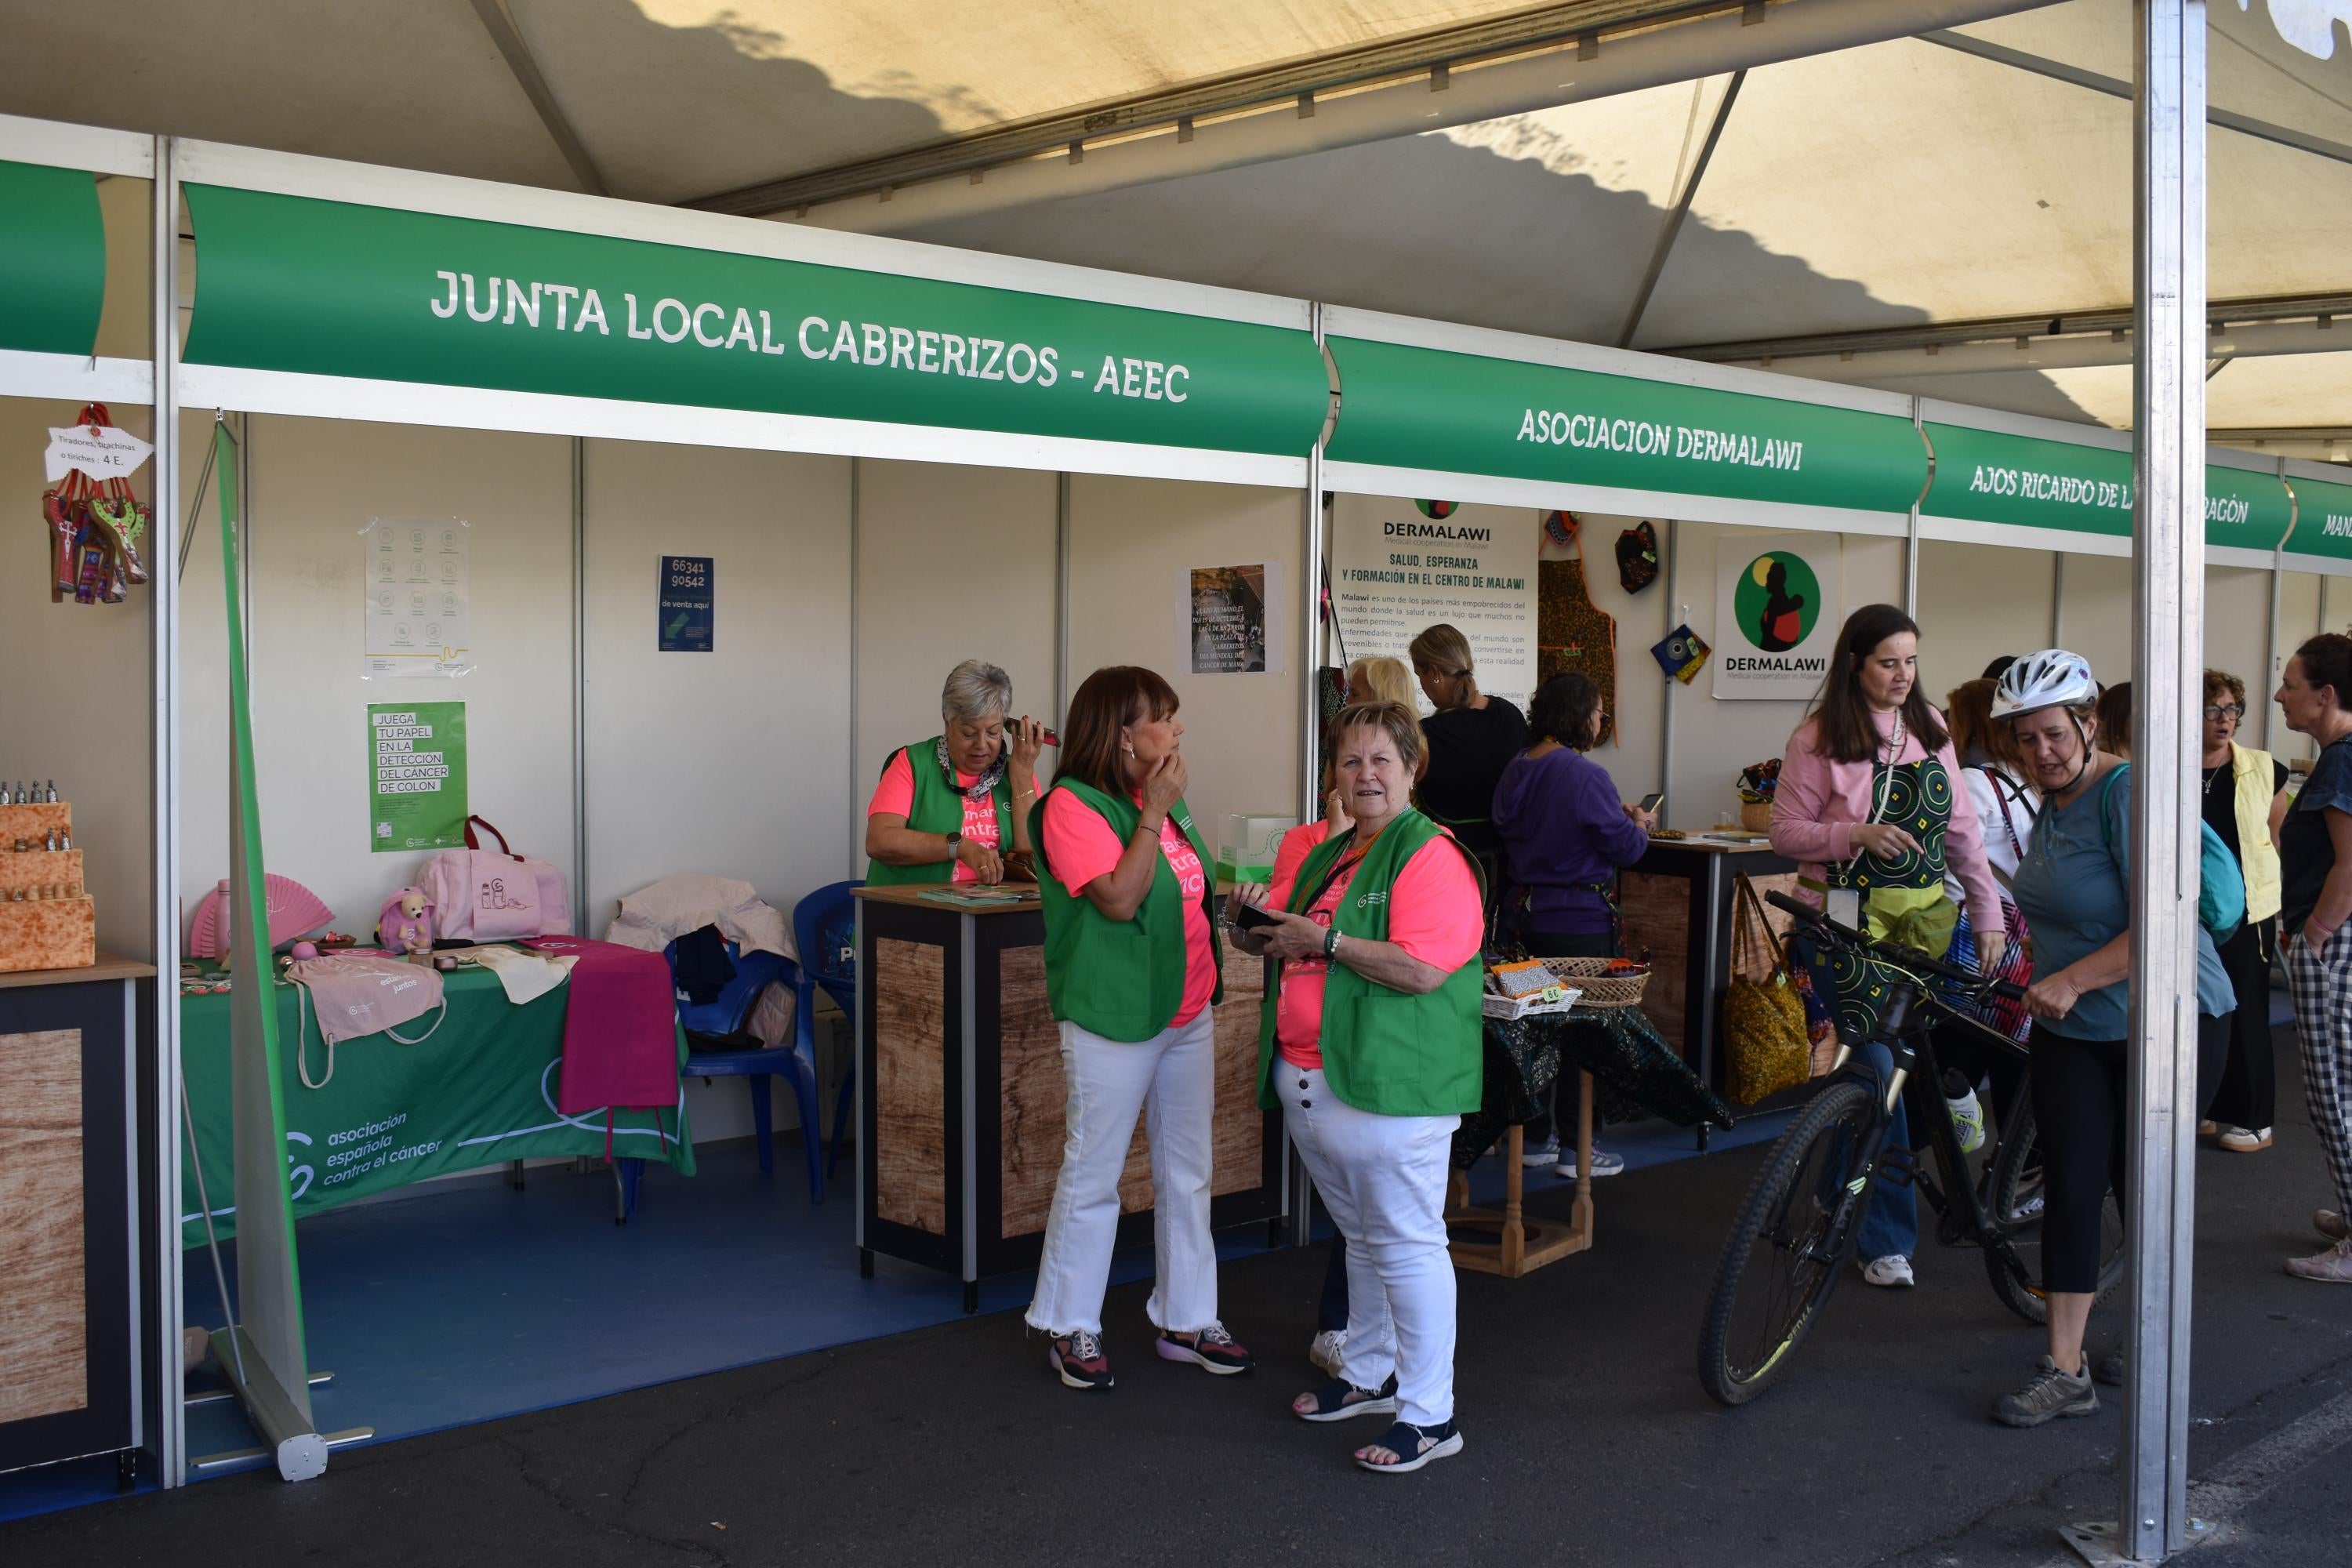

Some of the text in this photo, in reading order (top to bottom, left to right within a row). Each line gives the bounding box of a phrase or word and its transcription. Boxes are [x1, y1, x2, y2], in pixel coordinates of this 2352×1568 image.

[430, 270, 609, 335] JUNTA
[625, 293, 784, 354] LOCAL
[798, 316, 1058, 387] CABRERIZOS
[1094, 356, 1189, 402] AEEC
[58, 436, 136, 451] Tiradores, tirachinas
[1517, 409, 1802, 470] ASOCIACION DERMALAWI
[67, 453, 95, 463] tiriches
[103, 456, 110, 464] 4
[1969, 466, 2017, 495] AJOS
[2020, 472, 2095, 504] RICARDO
[2097, 482, 2118, 507] DE
[2121, 485, 2132, 509] L
[1384, 522, 1490, 541] DERMALAWI
[673, 559, 705, 574] 66341
[1426, 555, 1479, 570] ESPERANZA
[672, 575, 705, 587] 90542
[1342, 568, 1524, 590] Y FORMACIÓN EN EL CENTRO DE MALAWI
[1462, 600, 1512, 610] empobrecidos
[1452, 610, 1465, 619] lujo
[1341, 617, 1368, 626] pueden
[1341, 629, 1392, 637] Enfermedades
[1726, 658, 1824, 671] DERMALAWI
[379, 714, 415, 724] JUEGA
[379, 728, 430, 738] TU PAPEL
[379, 742, 412, 752] EN LA
[379, 753, 441, 765] DETECCIÓN
[380, 769, 401, 779] DEL
[380, 783, 394, 793] DE
[393, 979, 417, 994] juntos
[328, 1112, 407, 1146] asociación
[327, 1135, 393, 1167] española
[323, 1138, 442, 1186] contra el cáncer
